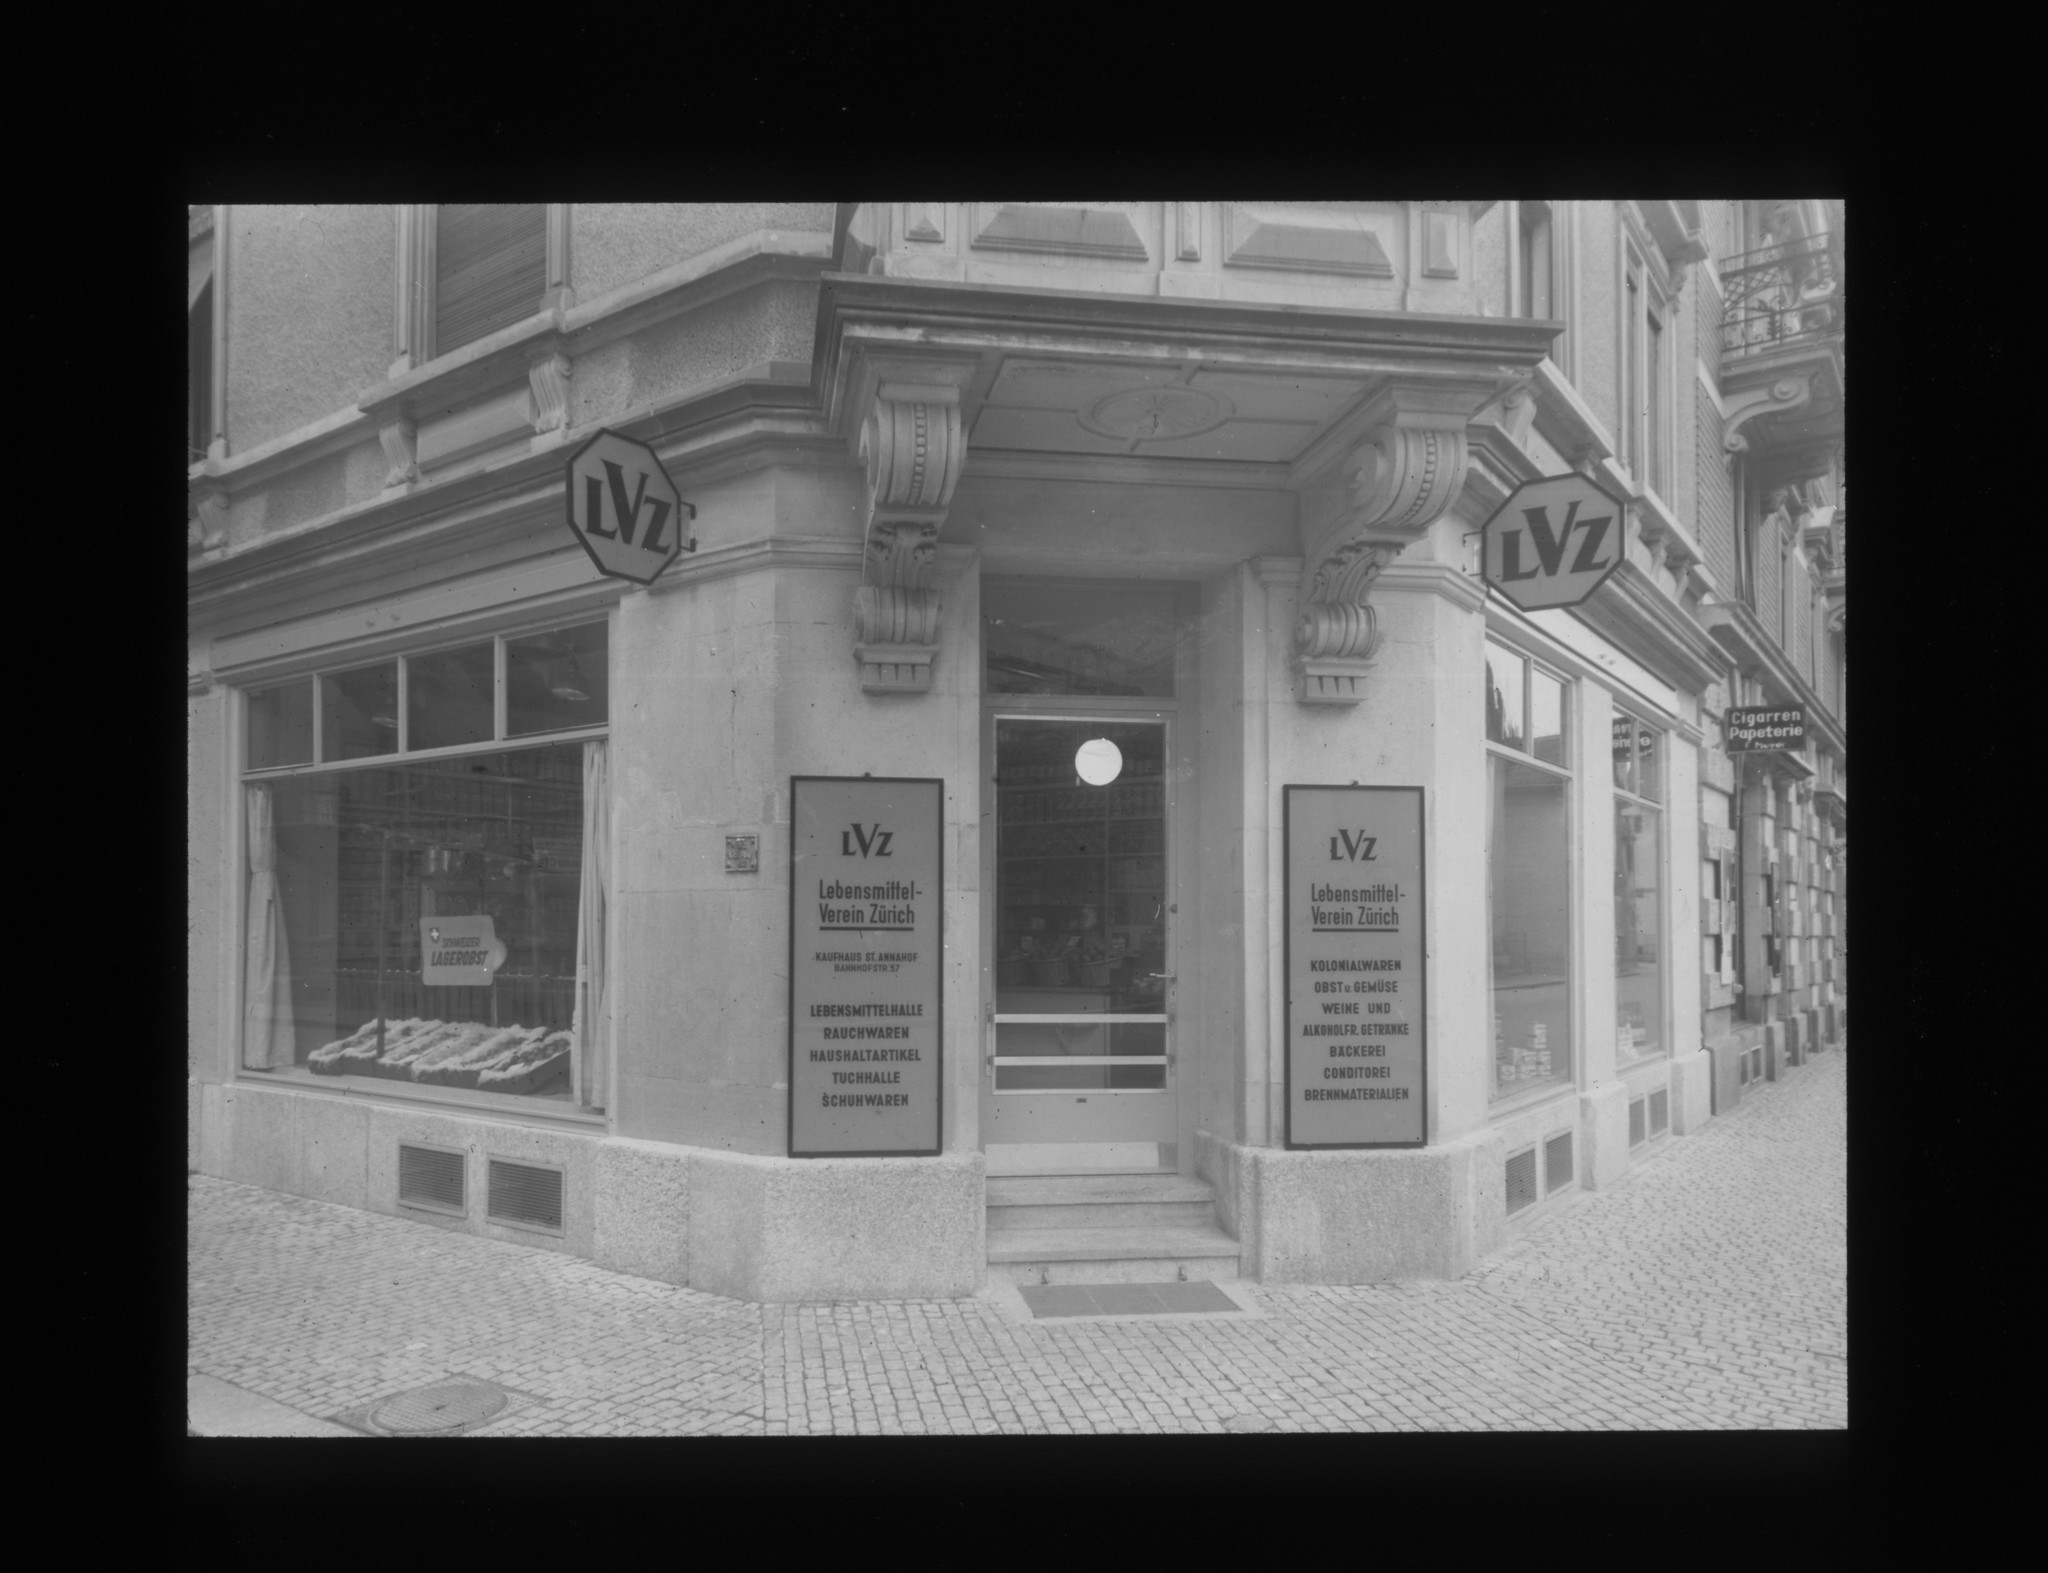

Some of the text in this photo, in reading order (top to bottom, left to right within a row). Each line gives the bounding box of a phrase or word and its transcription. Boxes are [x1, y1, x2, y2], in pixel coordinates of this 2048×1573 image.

[585, 460, 671, 555] LVZ
[1501, 500, 1613, 582] LVZ
[1731, 711, 1801, 727] Cigarren
[1729, 724, 1803, 741] Papeterie
[841, 823, 893, 859] LVZ
[1330, 829, 1377, 862] LVZ
[819, 880, 922, 900] Lebensmittel-
[1312, 883, 1406, 902] Lebensmittel-
[819, 904, 915, 924] Verein Zürich
[1312, 906, 1399, 925] Verein Zürich
[442, 937, 481, 948] SCHWEIZER
[430, 950, 489, 966] LAGEROBST
[816, 952, 862, 962] KAUFHAUS
[878, 952, 918, 962] ANNAHOF
[1311, 959, 1401, 972] KOLONIALWAREN
[1315, 981, 1343, 993] OBST
[1354, 980, 1398, 993] GEMÜSE
[811, 1004, 923, 1018] LEBENSMITTELHALLE
[1322, 1003, 1391, 1015] WEINE UND
[823, 1027, 909, 1039] RAUCHWAREN
[1303, 1022, 1409, 1036] ALKOHOLFR. GETRÄNKE
[810, 1049, 921, 1062] HAUSHALTARTIKEL
[1330, 1044, 1386, 1057] BÄCKEREI
[832, 1072, 901, 1084] TUCHHALLE
[1324, 1067, 1390, 1079] CONDITOREI
[822, 1094, 909, 1107] SCHUHWAREN
[1305, 1088, 1409, 1101] BRENNMATERIALIEN
